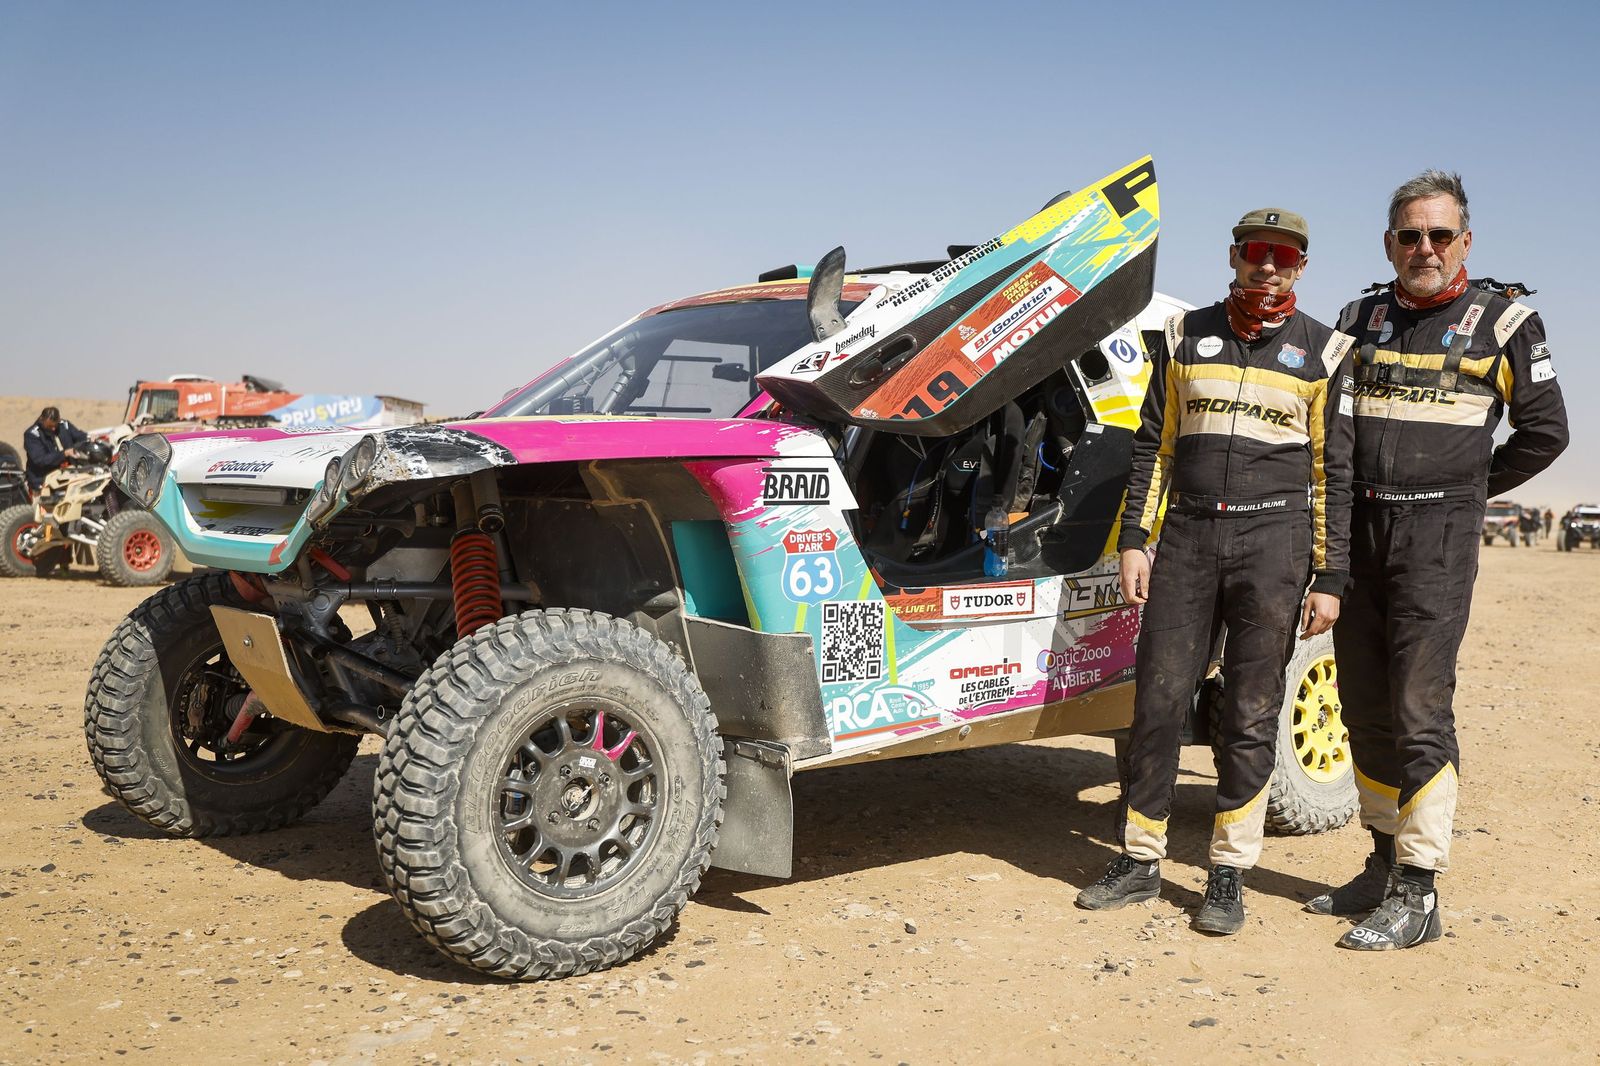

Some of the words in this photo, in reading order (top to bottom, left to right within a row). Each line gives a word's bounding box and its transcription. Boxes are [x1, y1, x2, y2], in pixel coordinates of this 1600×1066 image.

[1102, 160, 1157, 218] P
[876, 277, 928, 309] MAXIME
[932, 236, 1001, 276] GUILLAUME
[892, 281, 932, 307] HERVE
[934, 240, 1004, 282] GUILLAUME
[1010, 284, 1031, 305] LIVE
[974, 285, 1053, 350] BFGoodrich
[1462, 307, 1480, 333] SIMPSON
[1502, 309, 1525, 333] MARINA
[991, 301, 1070, 365] MOTUL
[1330, 339, 1347, 360] MARINA
[889, 370, 969, 419] 19
[1354, 383, 1456, 405] ROPARC
[1186, 398, 1295, 427] PROPARC
[207, 460, 275, 473] BFGoodrich
[763, 473, 830, 499] BRAID
[1376, 491, 1445, 501] H.GUILLAUME
[1227, 500, 1287, 512] M.GUILLAUME
[789, 532, 832, 544] DRIVER'S
[798, 542, 824, 553] PARK
[789, 556, 834, 597] 63
[905, 604, 925, 614] LIVE
[964, 594, 1013, 608] TUDOR
[950, 657, 1021, 680] omerin
[1045, 648, 1080, 672] Optic
[1081, 646, 1111, 662] 2000
[961, 681, 976, 693] LES
[977, 676, 1010, 690] CABLES
[1053, 668, 1102, 691] AUBIERE
[968, 686, 1015, 703] L'EXTREME
[832, 688, 895, 733] RCA
